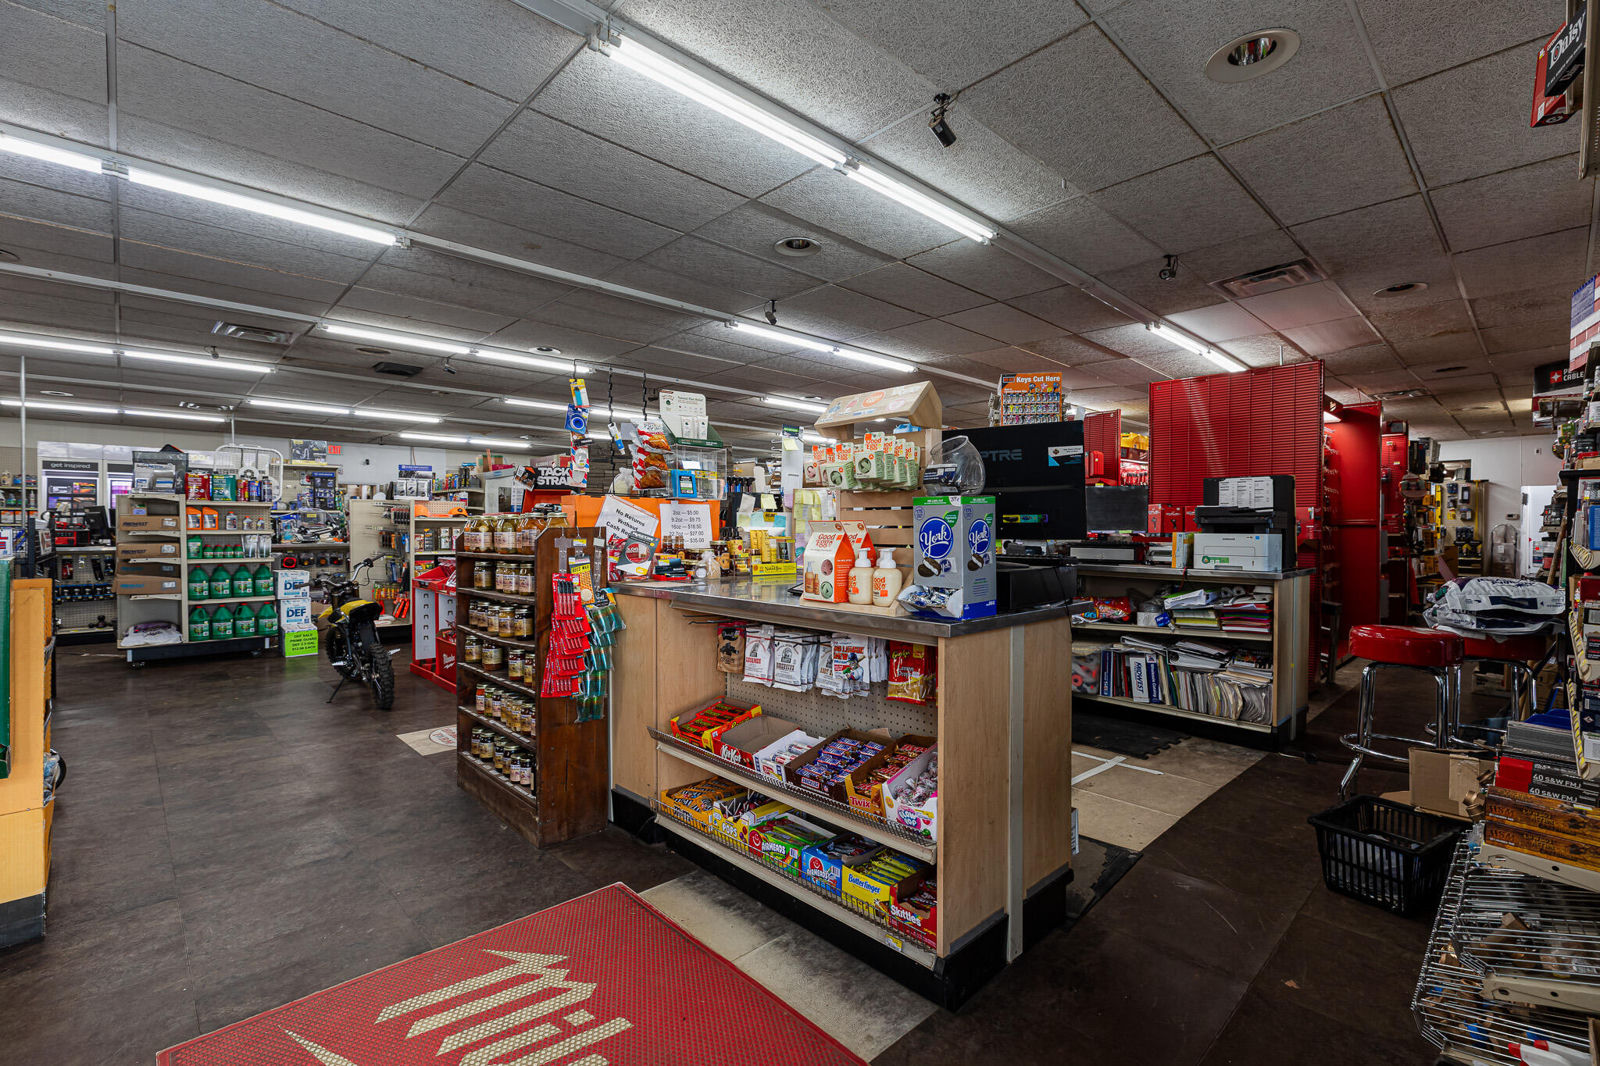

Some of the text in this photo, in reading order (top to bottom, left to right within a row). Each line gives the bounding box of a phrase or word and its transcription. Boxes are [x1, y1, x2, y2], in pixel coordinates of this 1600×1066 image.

[1016, 376, 1031, 384] Keys
[328, 445, 341, 454] EXIT
[538, 468, 570, 477] TACK
[537, 476, 570, 486] STRA
[615, 508, 645, 527] No Returns
[606, 521, 620, 532] Cash
[920, 524, 951, 559] York
[968, 524, 989, 556] York
[286, 608, 307, 618] DEF
[1135, 661, 1145, 693] MIDWEST
[1533, 773, 1582, 788] 40 S&W FMJ
[1529, 786, 1578, 803] 40 S&W FMJ
[849, 796, 870, 809] Twix
[722, 822, 738, 838] POPS
[848, 873, 881, 894] Butterfinger
[890, 904, 922, 927] Skittles
